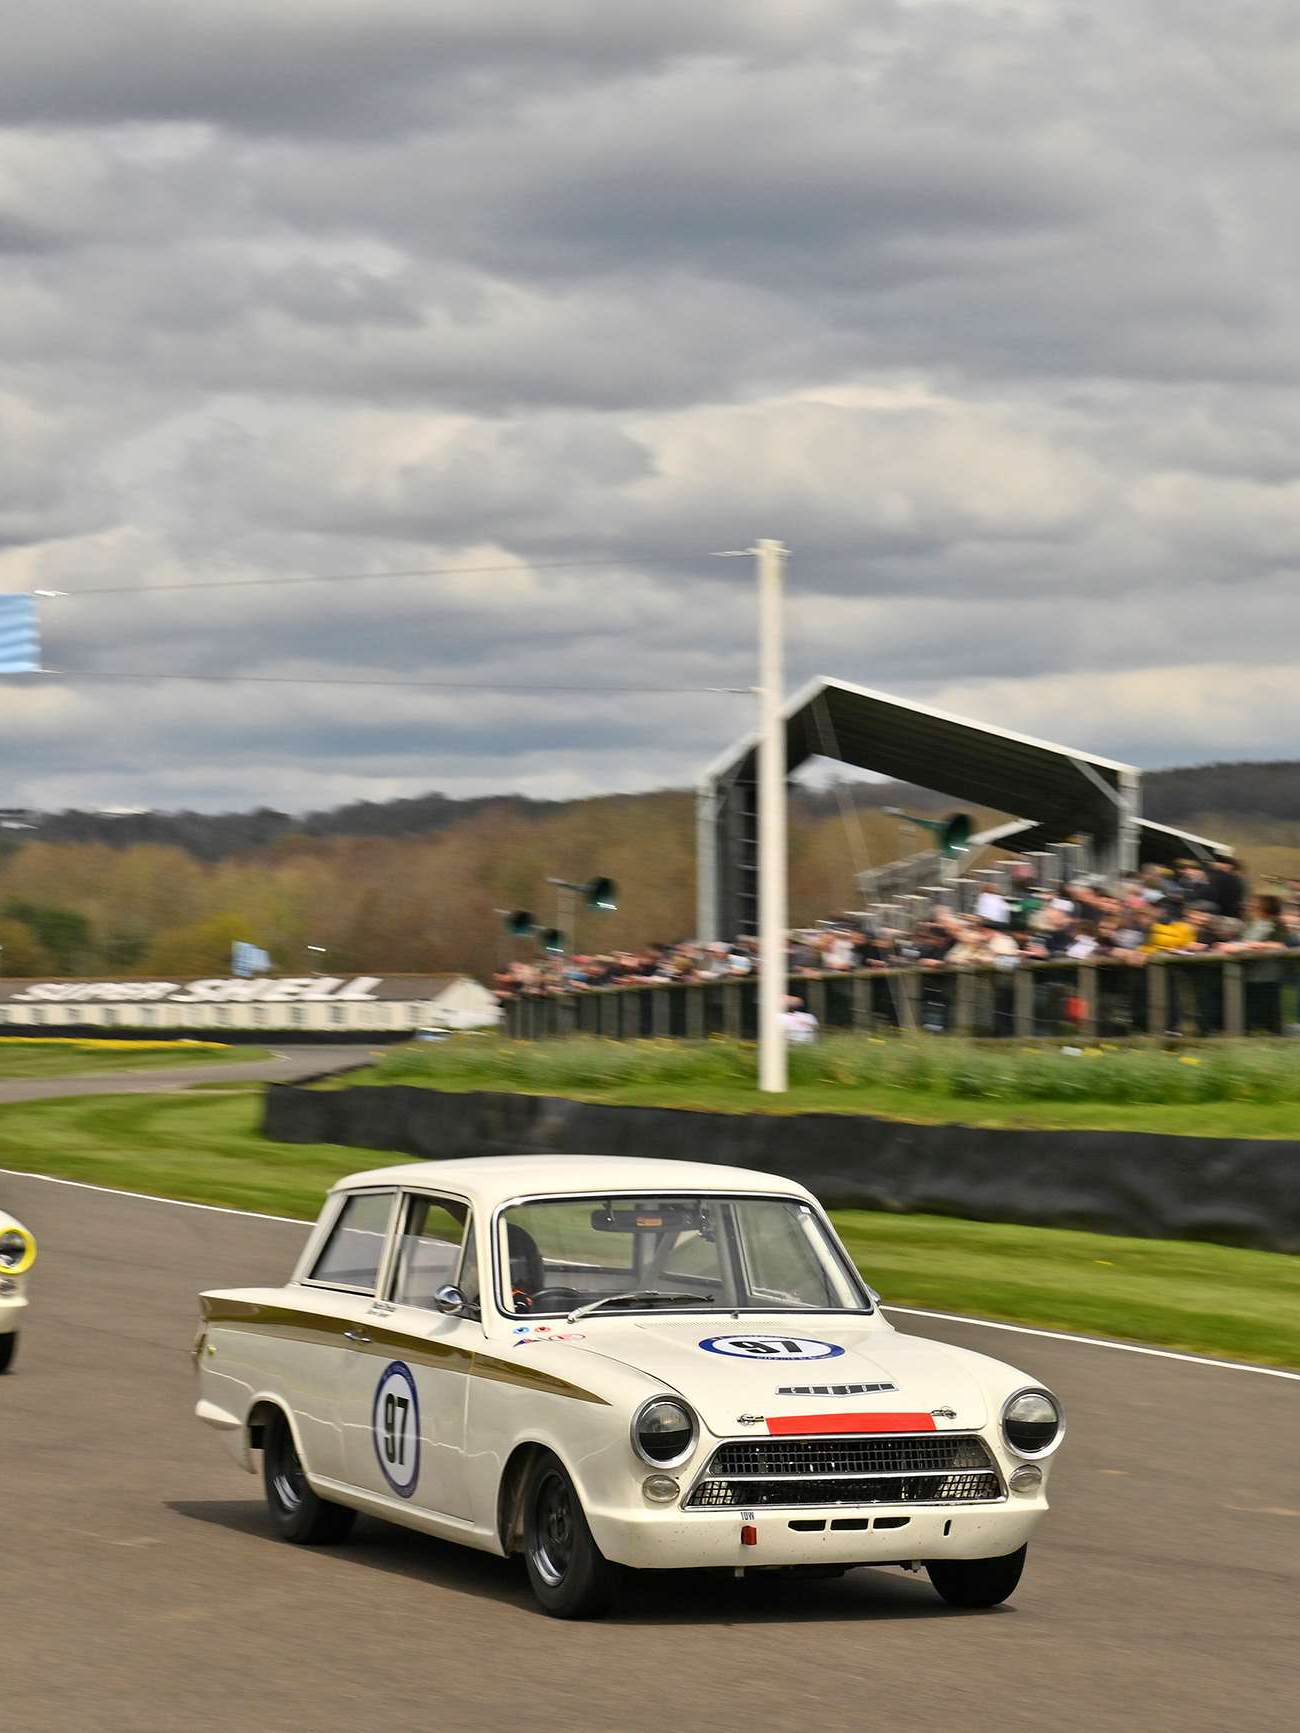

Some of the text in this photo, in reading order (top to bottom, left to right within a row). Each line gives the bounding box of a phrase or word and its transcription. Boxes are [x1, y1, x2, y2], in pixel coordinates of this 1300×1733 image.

[171, 976, 385, 1003] SHELL
[729, 1340, 803, 1354] 97
[384, 1392, 410, 1466] 97
